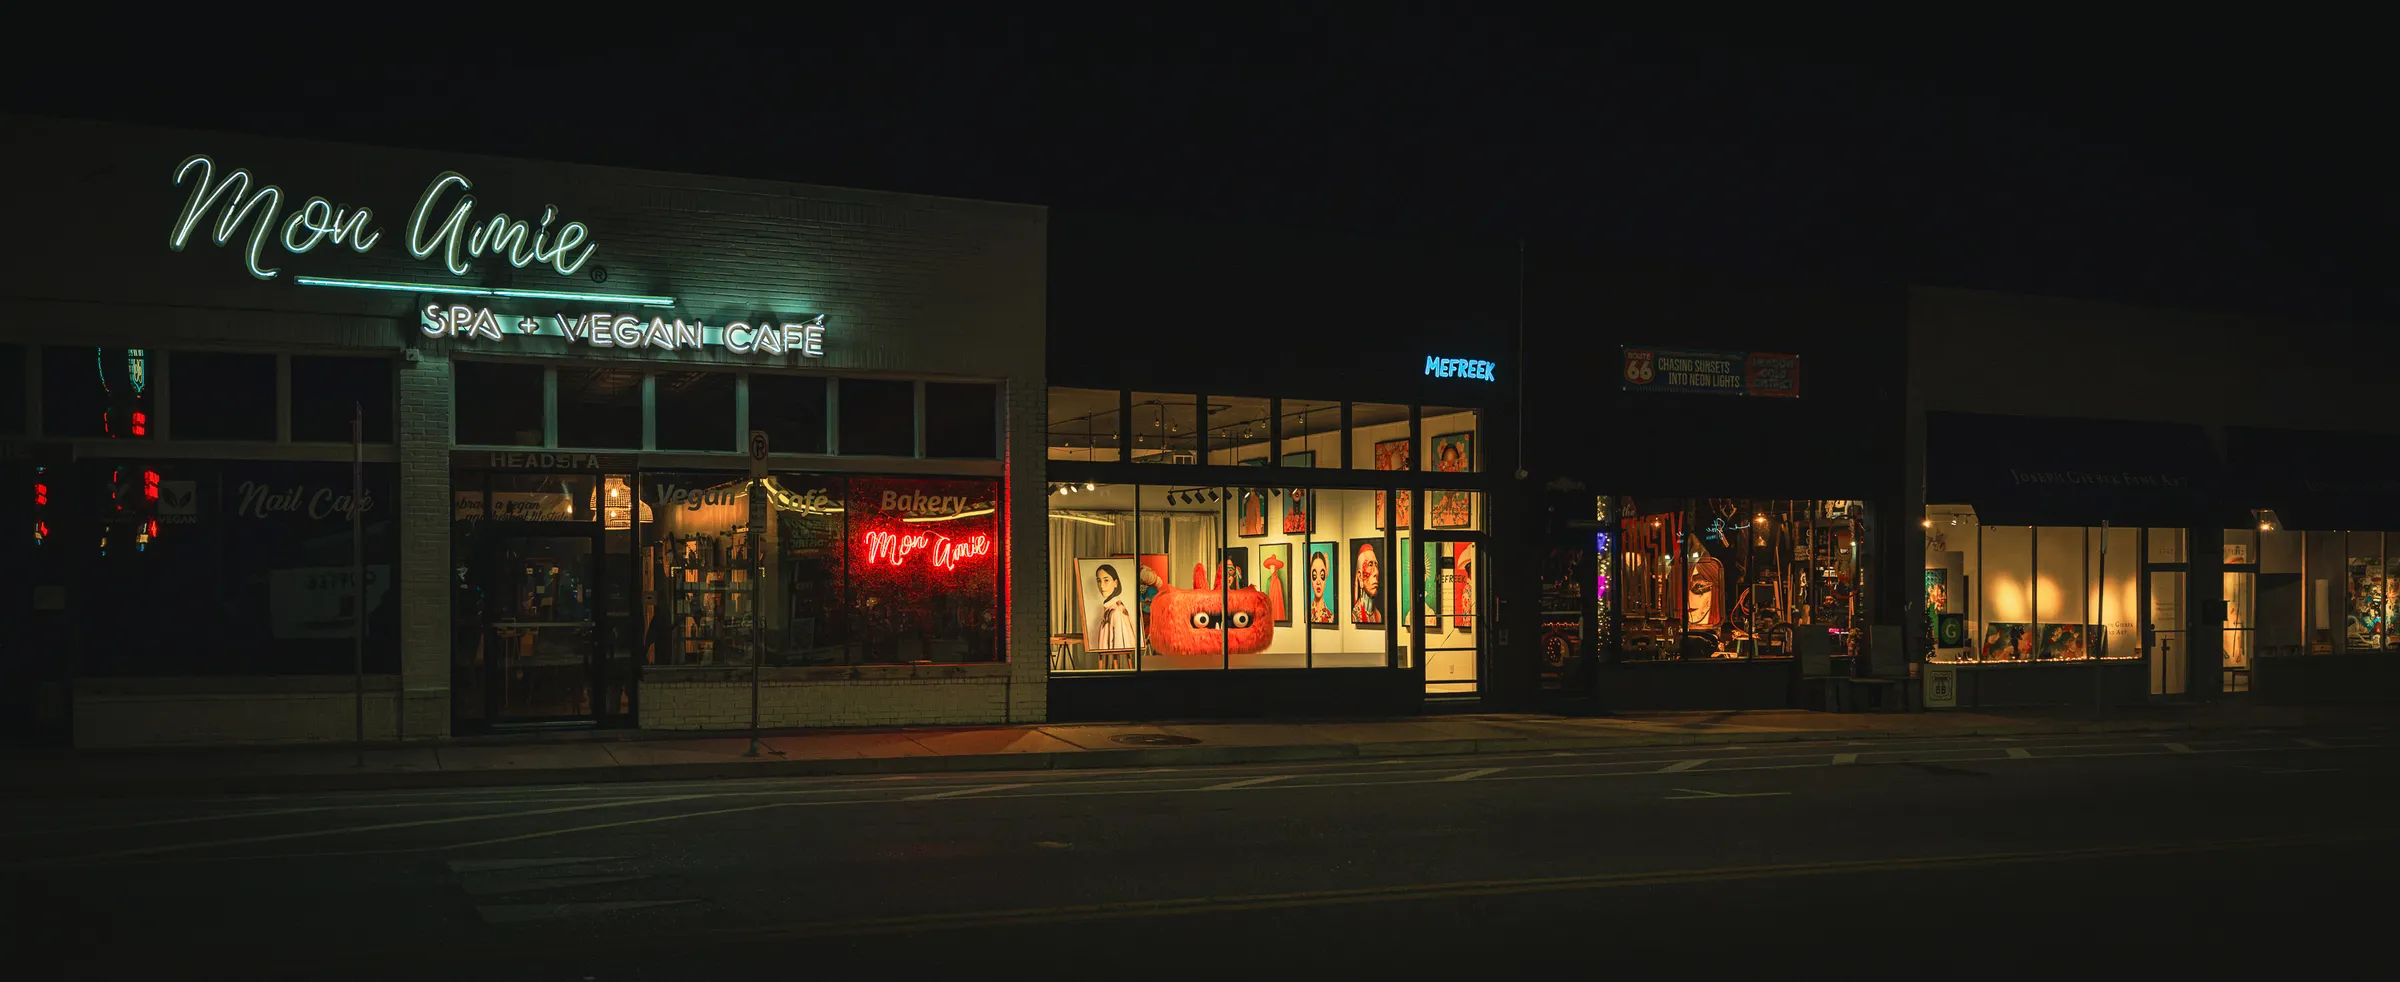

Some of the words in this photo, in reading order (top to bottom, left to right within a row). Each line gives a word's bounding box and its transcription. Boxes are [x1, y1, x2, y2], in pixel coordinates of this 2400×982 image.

[170, 154, 386, 281] Mon
[406, 170, 599, 276] Amie
[421, 304, 504, 343] SPA
[555, 312, 704, 352] VEGAN
[720, 314, 828, 359] CAFÉ
[1424, 355, 1496, 382] MEFREEK
[1626, 352, 1653, 361] ROUTE
[1626, 360, 1653, 381] 66
[1657, 357, 1694, 373] CHASING
[1694, 359, 1731, 375] SUNSETS
[1667, 372, 1689, 386] INTO
[1689, 374, 1712, 388] NEON
[1713, 375, 1741, 389] LIGHTS
[238, 480, 304, 519] Nail
[657, 484, 736, 511] Vegan
[773, 487, 829, 517] Café
[881, 489, 968, 518] Bakery
[864, 530, 929, 566] Mon
[932, 531, 991, 571] Amie
